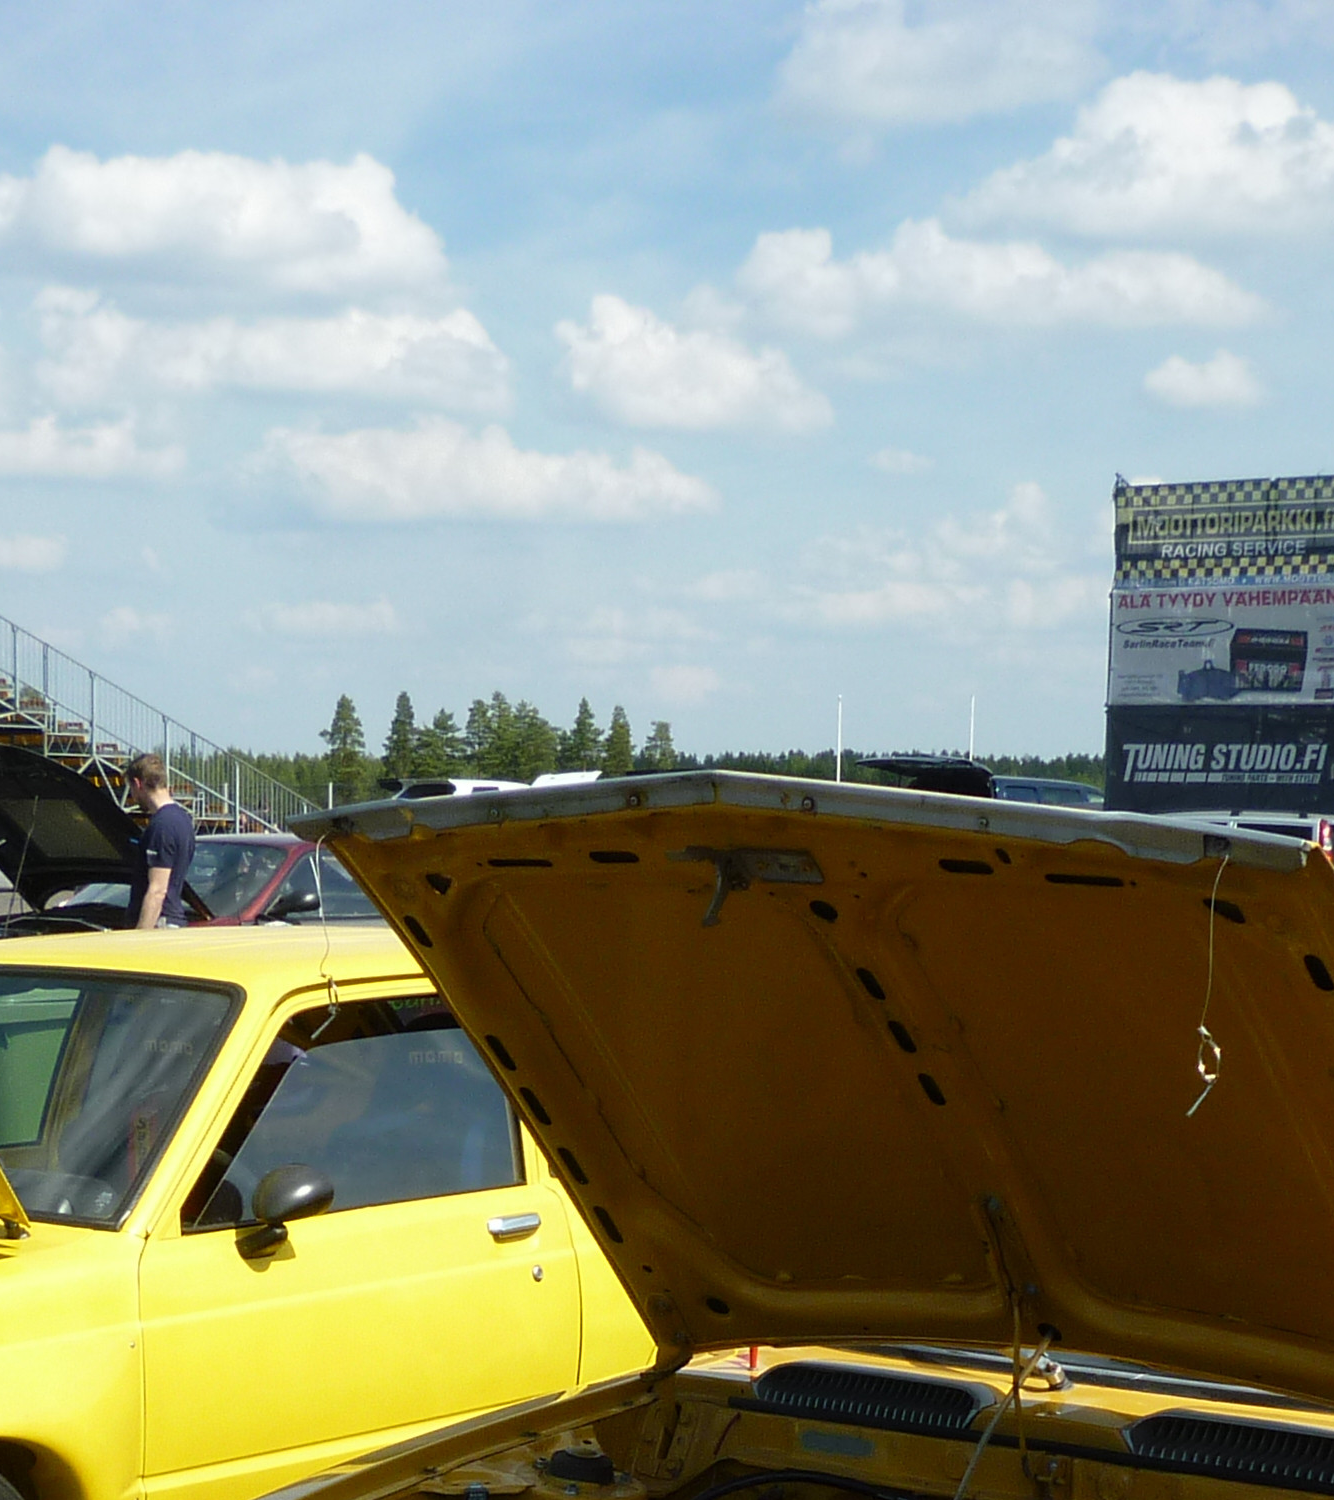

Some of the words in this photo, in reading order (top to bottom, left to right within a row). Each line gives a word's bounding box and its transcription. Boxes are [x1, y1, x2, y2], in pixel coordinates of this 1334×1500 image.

[1161, 543, 1228, 559] RACING
[1231, 540, 1307, 557] SERVICE
[1117, 592, 1153, 609] ÄLÄ
[1156, 591, 1216, 608] TYYDY
[1122, 742, 1207, 782] TUNING
[1210, 743, 1329, 771] STUDIO.FI
